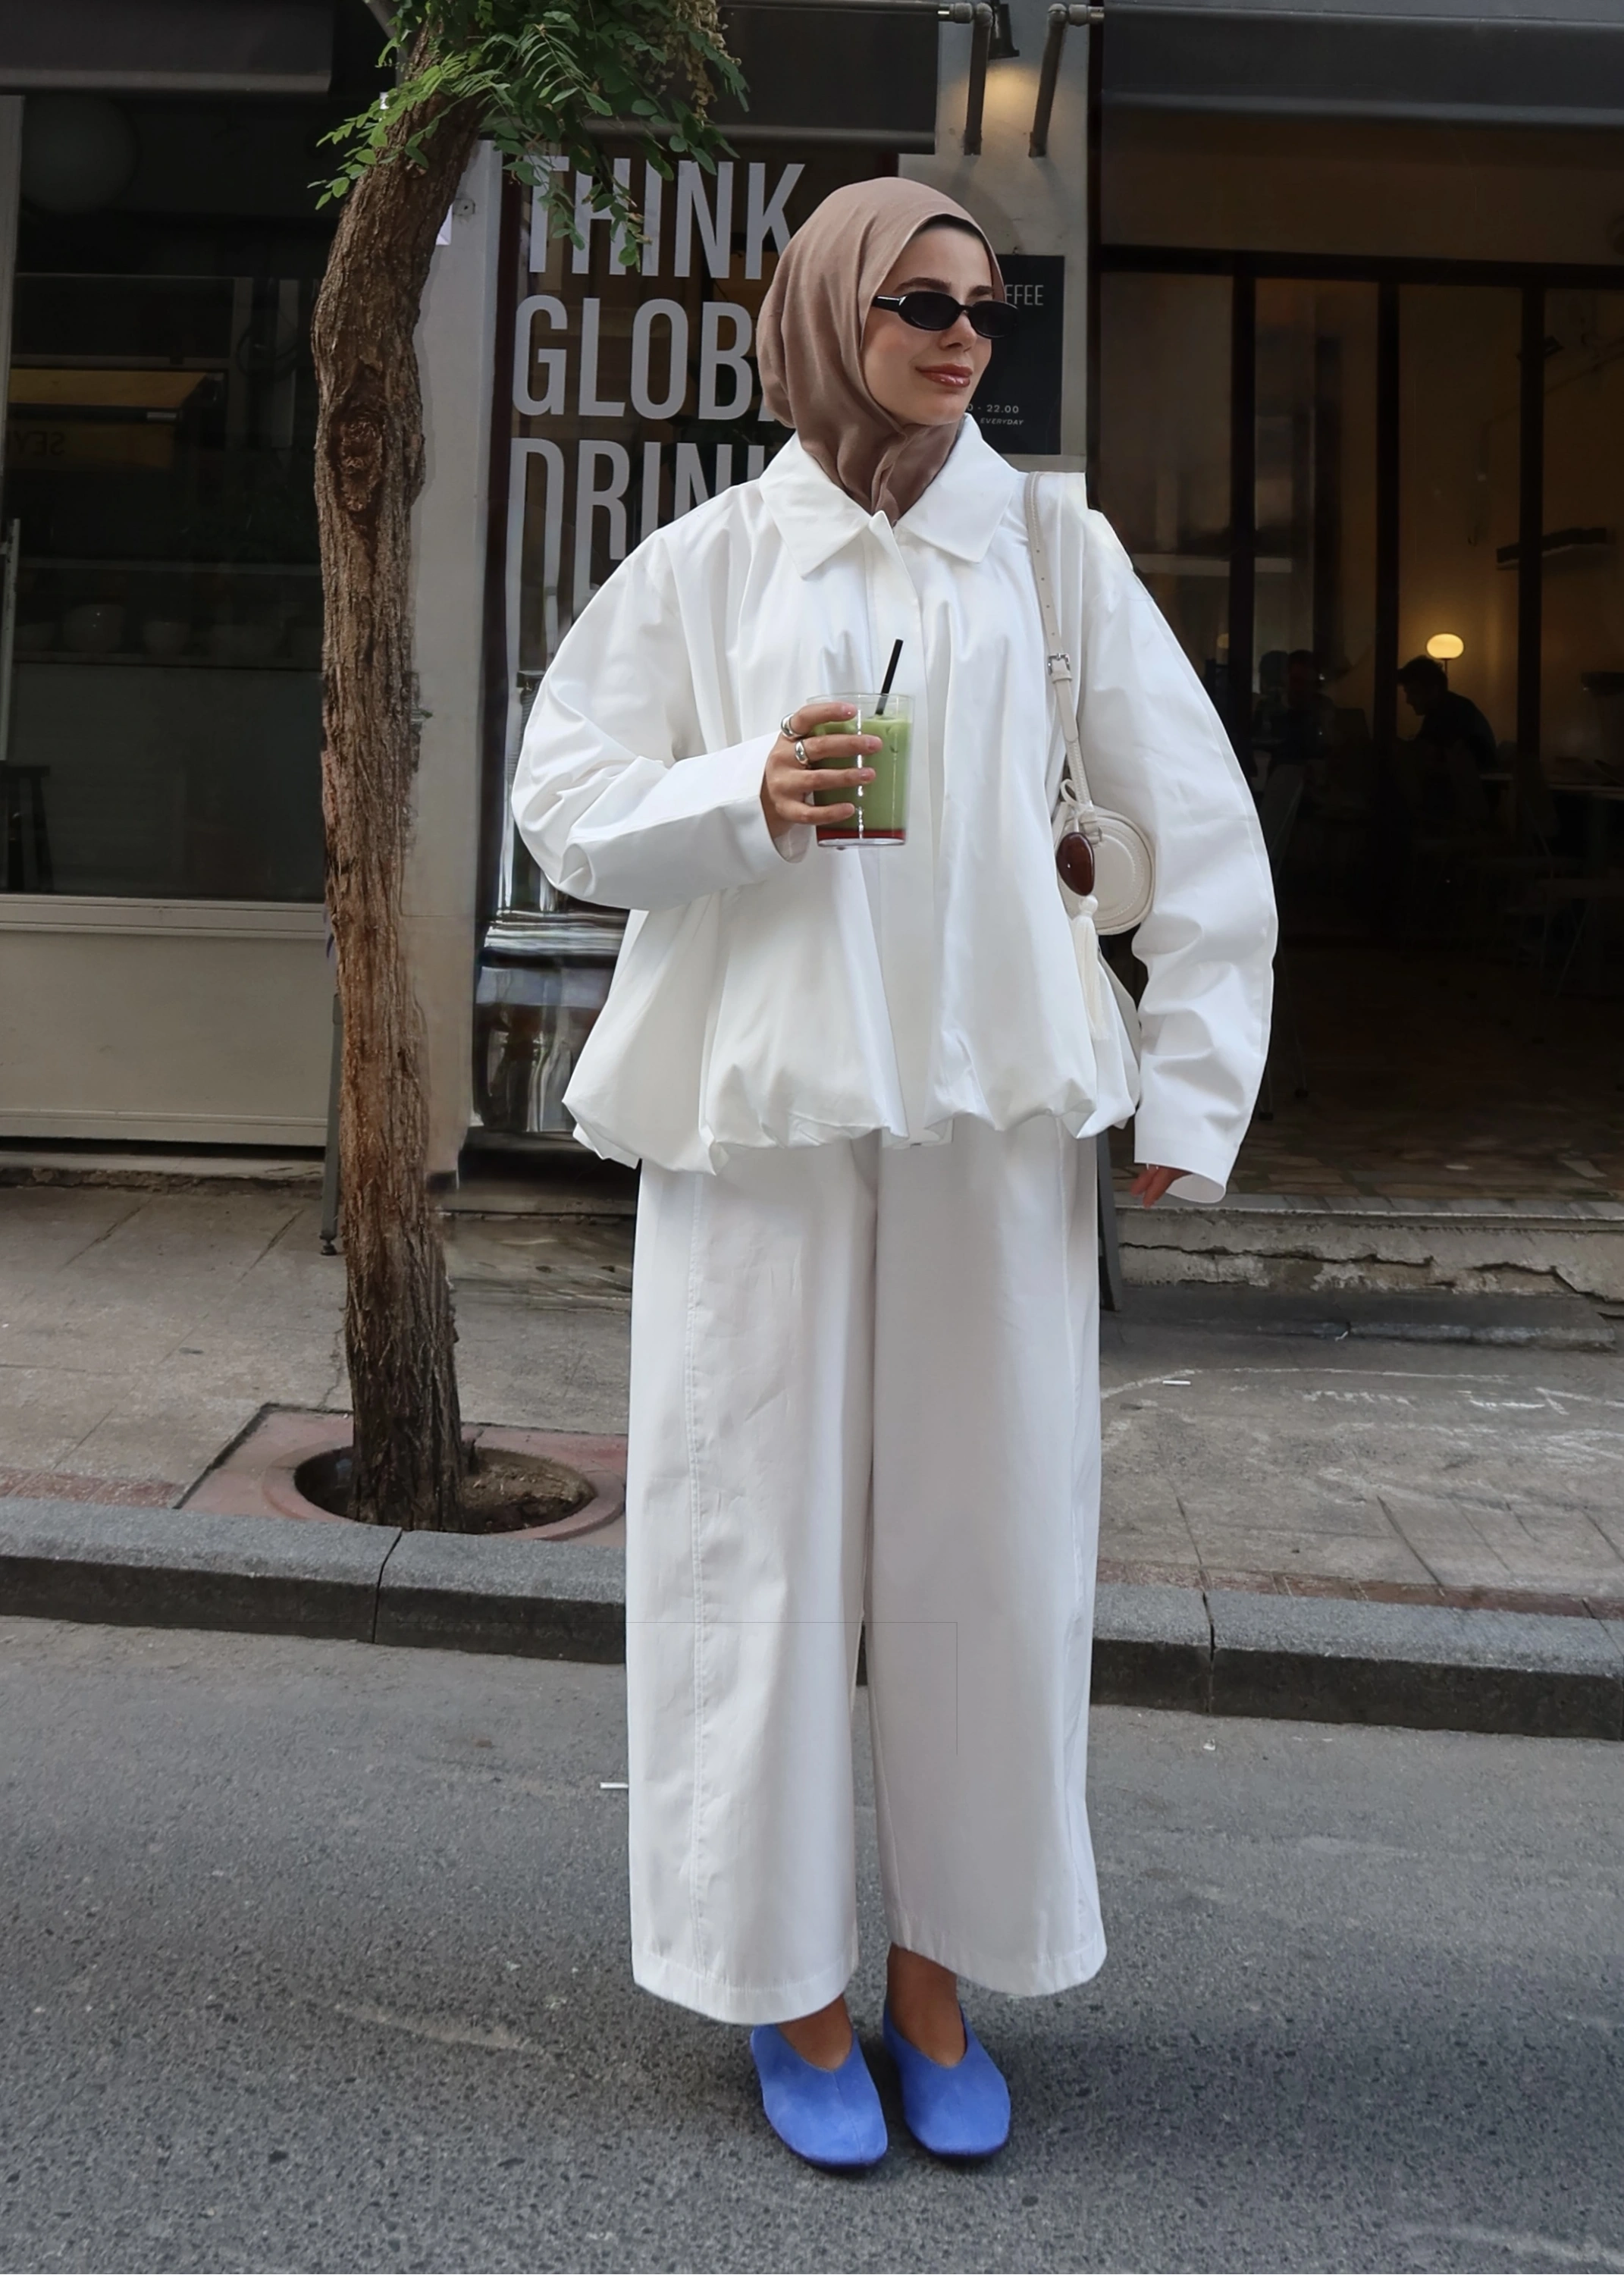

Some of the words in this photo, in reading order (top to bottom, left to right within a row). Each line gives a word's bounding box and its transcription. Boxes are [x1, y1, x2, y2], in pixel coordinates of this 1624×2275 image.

[522, 155, 806, 280] THINK
[1005, 284, 1044, 306] FFEE
[512, 294, 776, 422] GLOB
[986, 404, 1020, 413] 22.00
[506, 438, 765, 565] DRIN
